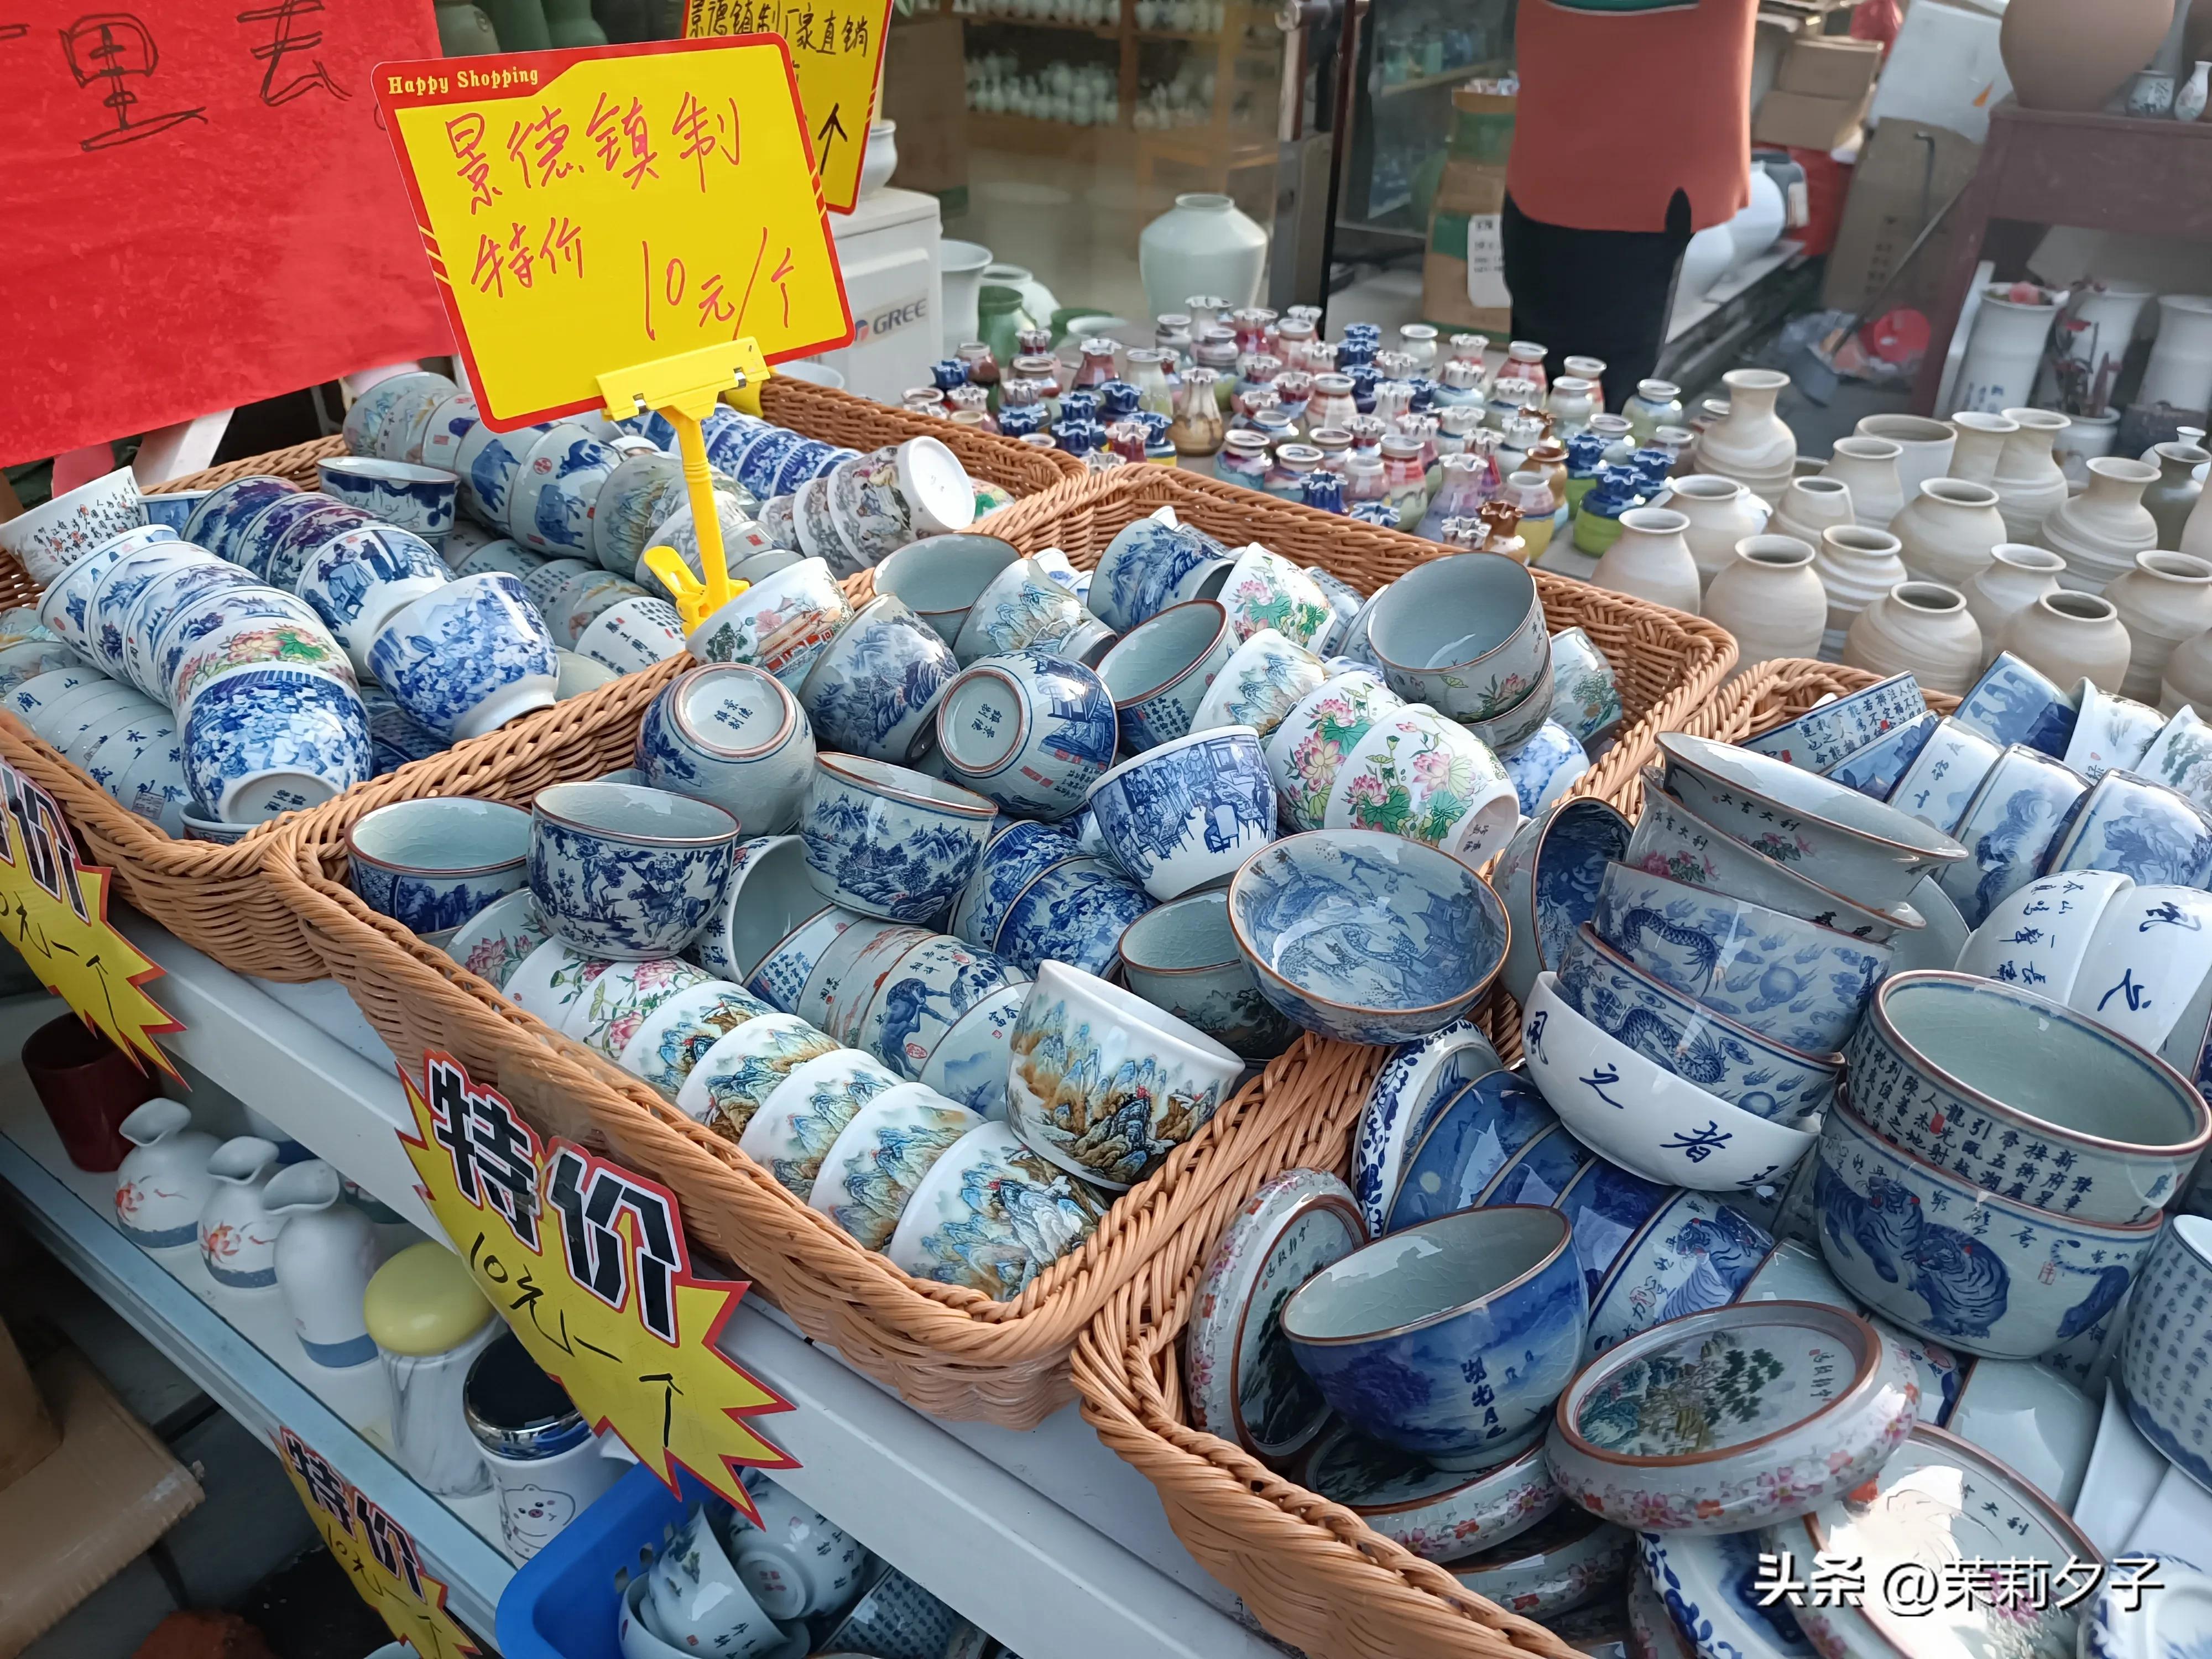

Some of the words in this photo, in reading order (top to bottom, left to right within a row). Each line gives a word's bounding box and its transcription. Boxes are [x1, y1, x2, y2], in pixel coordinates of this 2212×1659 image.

[0, 0, 352, 151] 里去
[388, 74, 448, 95] Happy
[457, 67, 539, 88] Shopping
[445, 90, 742, 215] 景德镇制
[469, 216, 585, 298] 特价
[872, 298, 927, 335] GREE
[1720, 792, 1802, 832] 大吉大利
[430, 1060, 679, 1343] 特价
[284, 1434, 427, 1603] 特价
